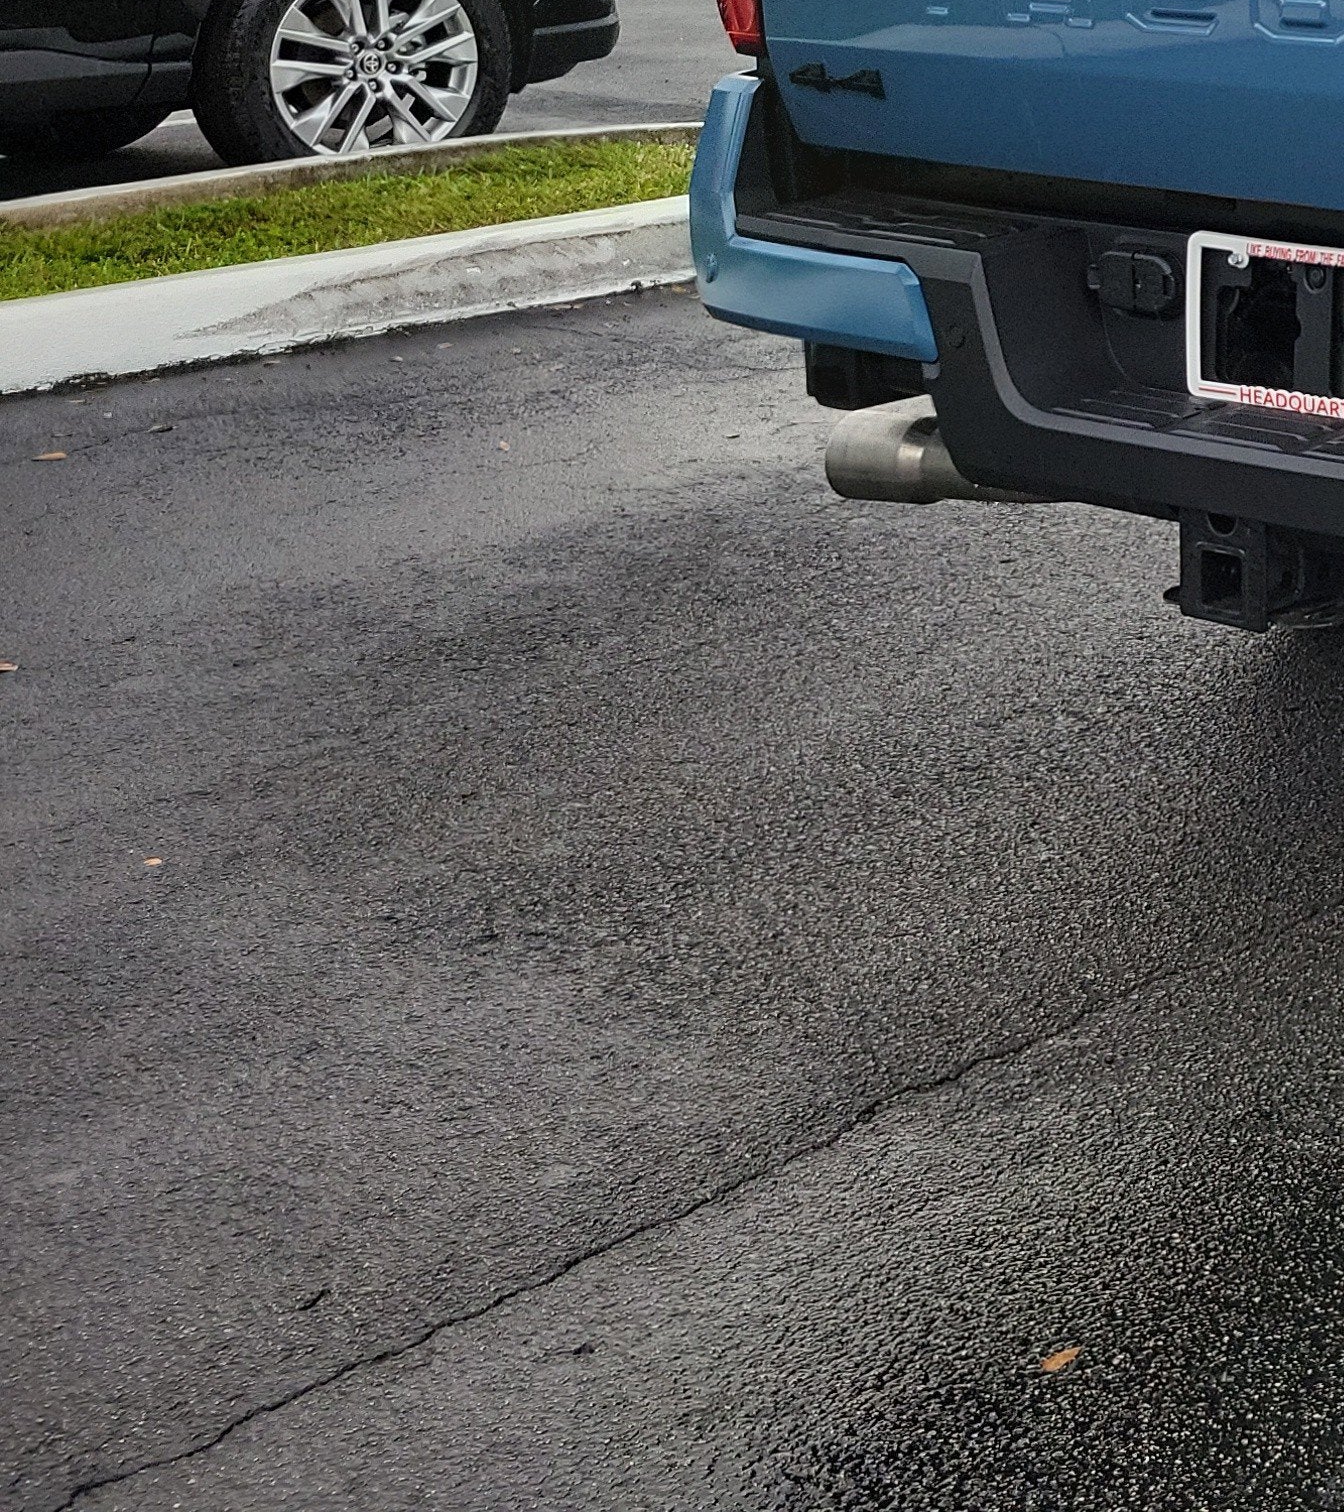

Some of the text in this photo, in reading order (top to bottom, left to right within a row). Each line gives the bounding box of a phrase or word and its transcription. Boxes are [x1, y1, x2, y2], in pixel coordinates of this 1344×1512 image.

[1246, 242, 1262, 258] LIKE
[1264, 245, 1292, 262] BUYING
[1295, 248, 1317, 264] FROM
[1319, 251, 1334, 266] THE
